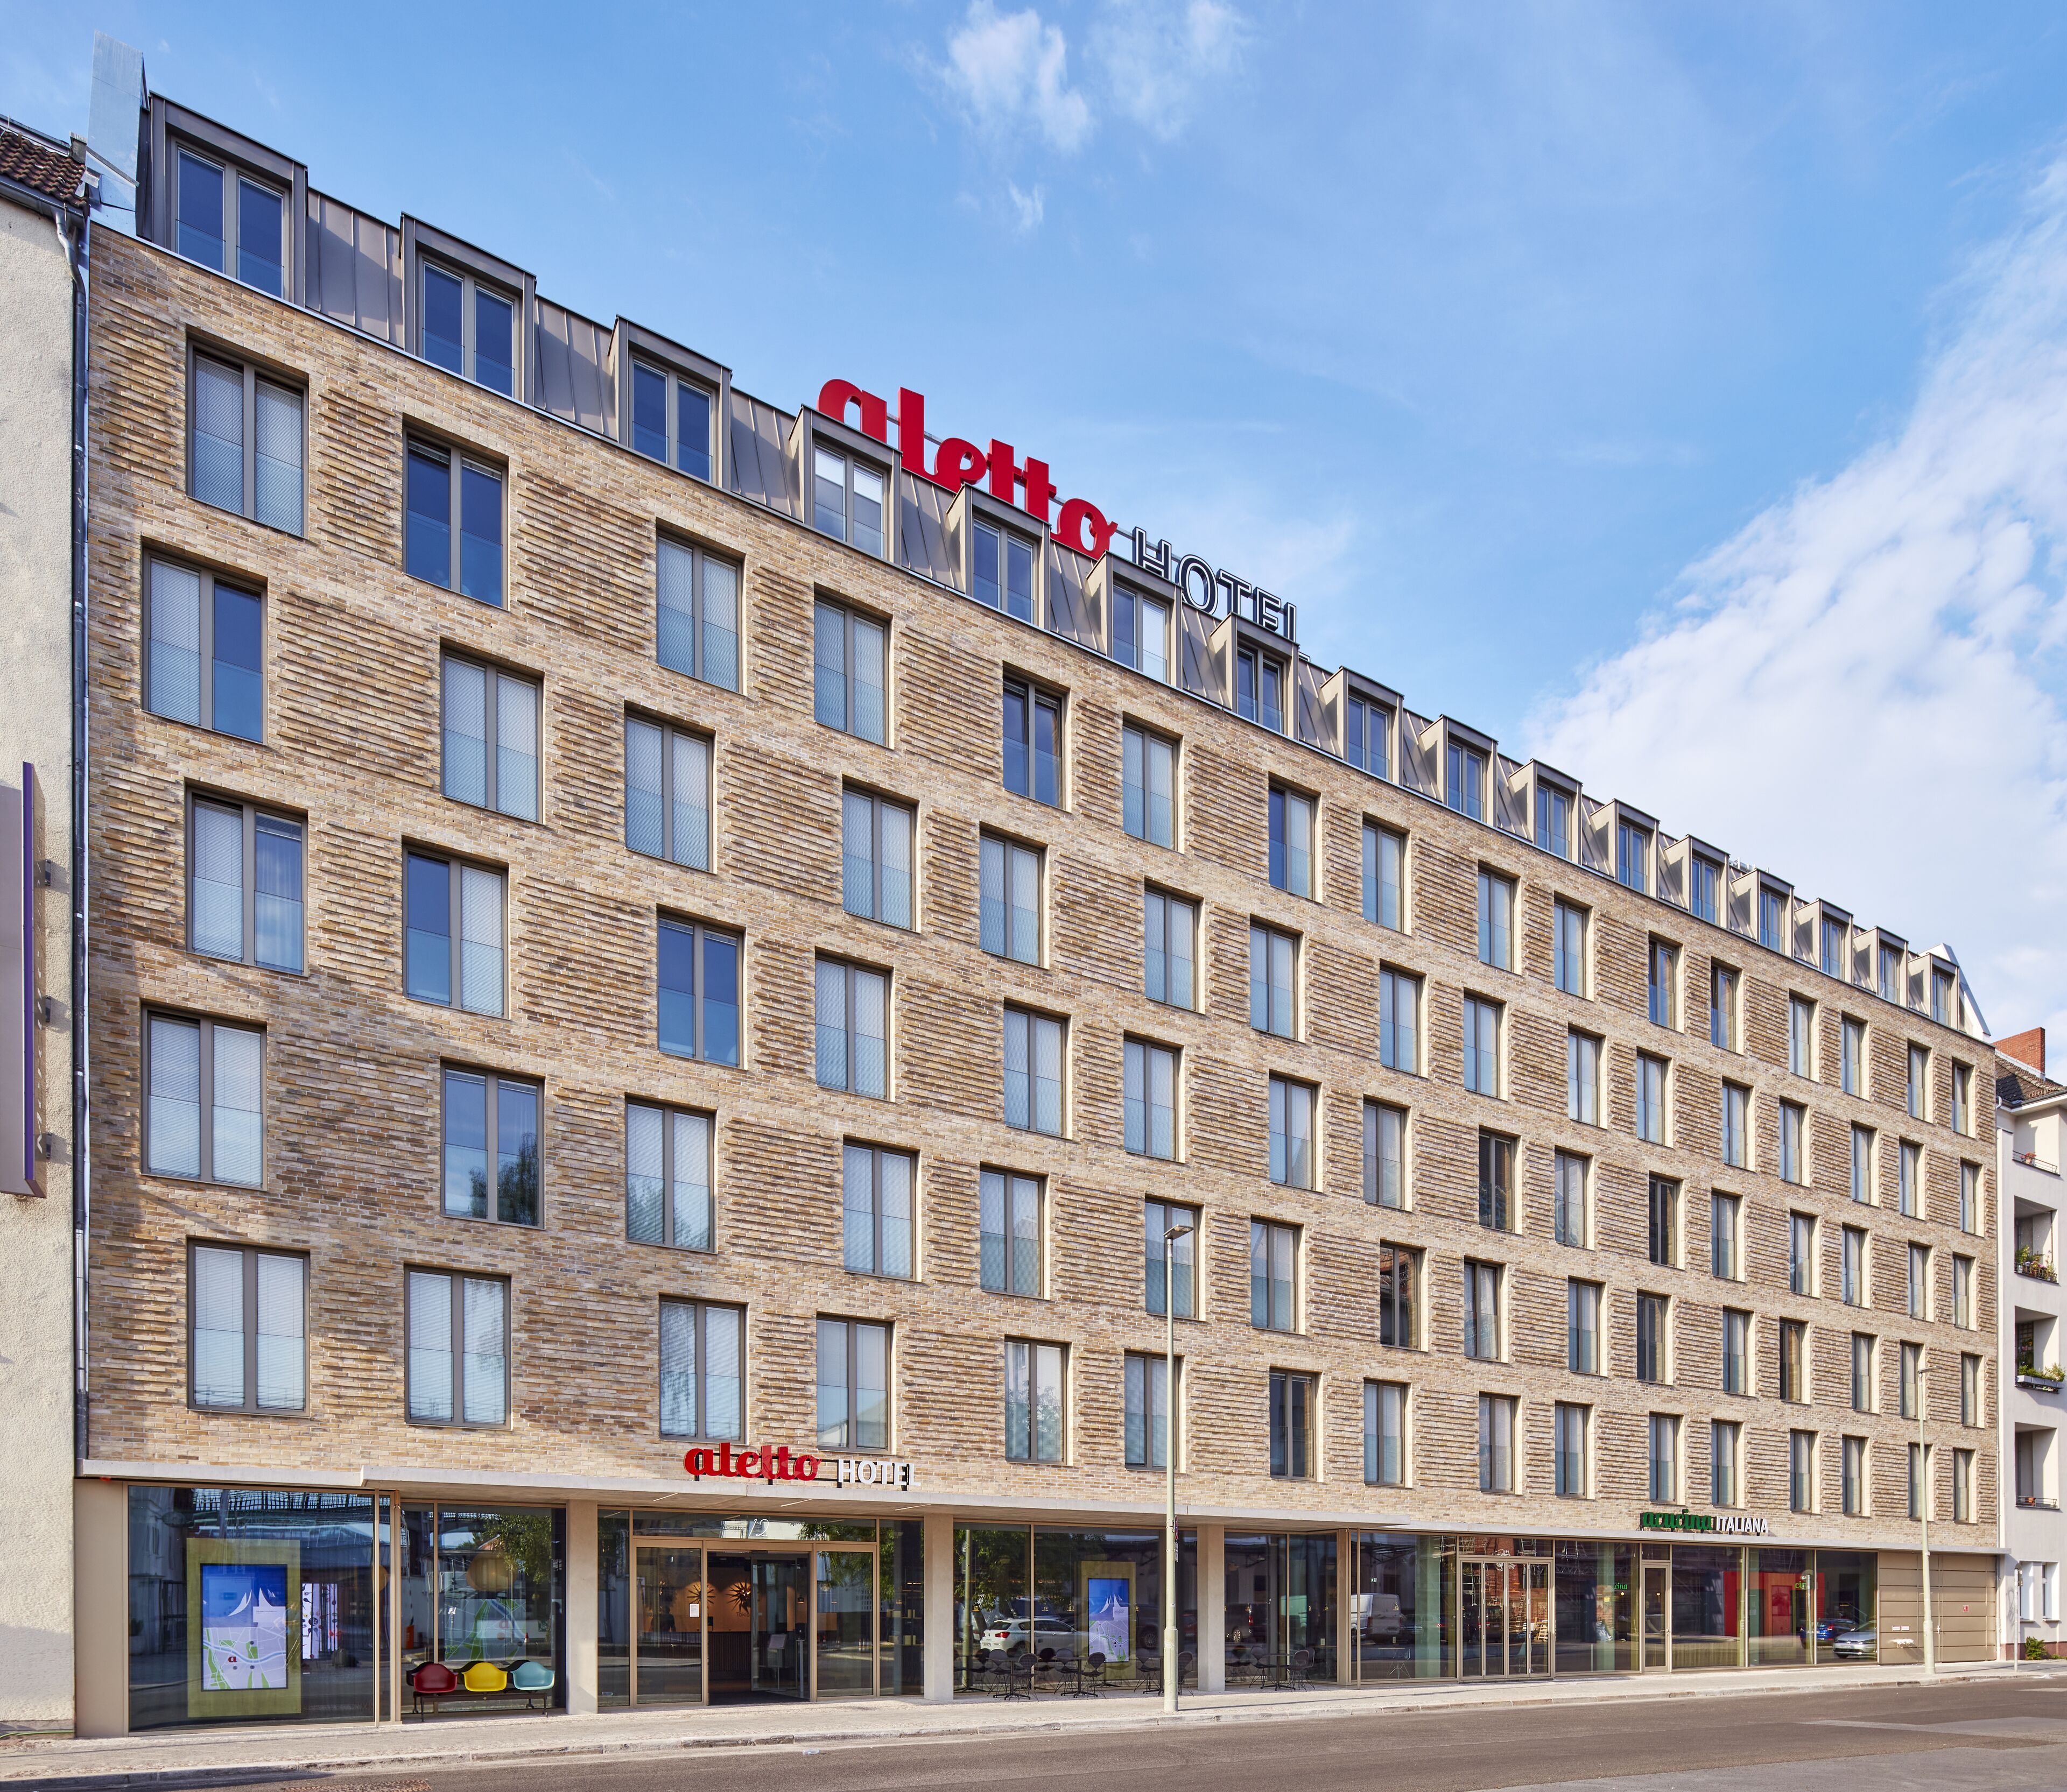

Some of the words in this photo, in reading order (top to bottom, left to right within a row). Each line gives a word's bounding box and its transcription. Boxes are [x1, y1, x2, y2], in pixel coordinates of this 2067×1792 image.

[817, 378, 1118, 561] aletto
[684, 1442, 822, 1481] aletto
[837, 1458, 921, 1487] HOTEL
[749, 1518, 769, 1537] 12
[1642, 1508, 1713, 1530] acucina
[1716, 1515, 1769, 1533] ITALIANA
